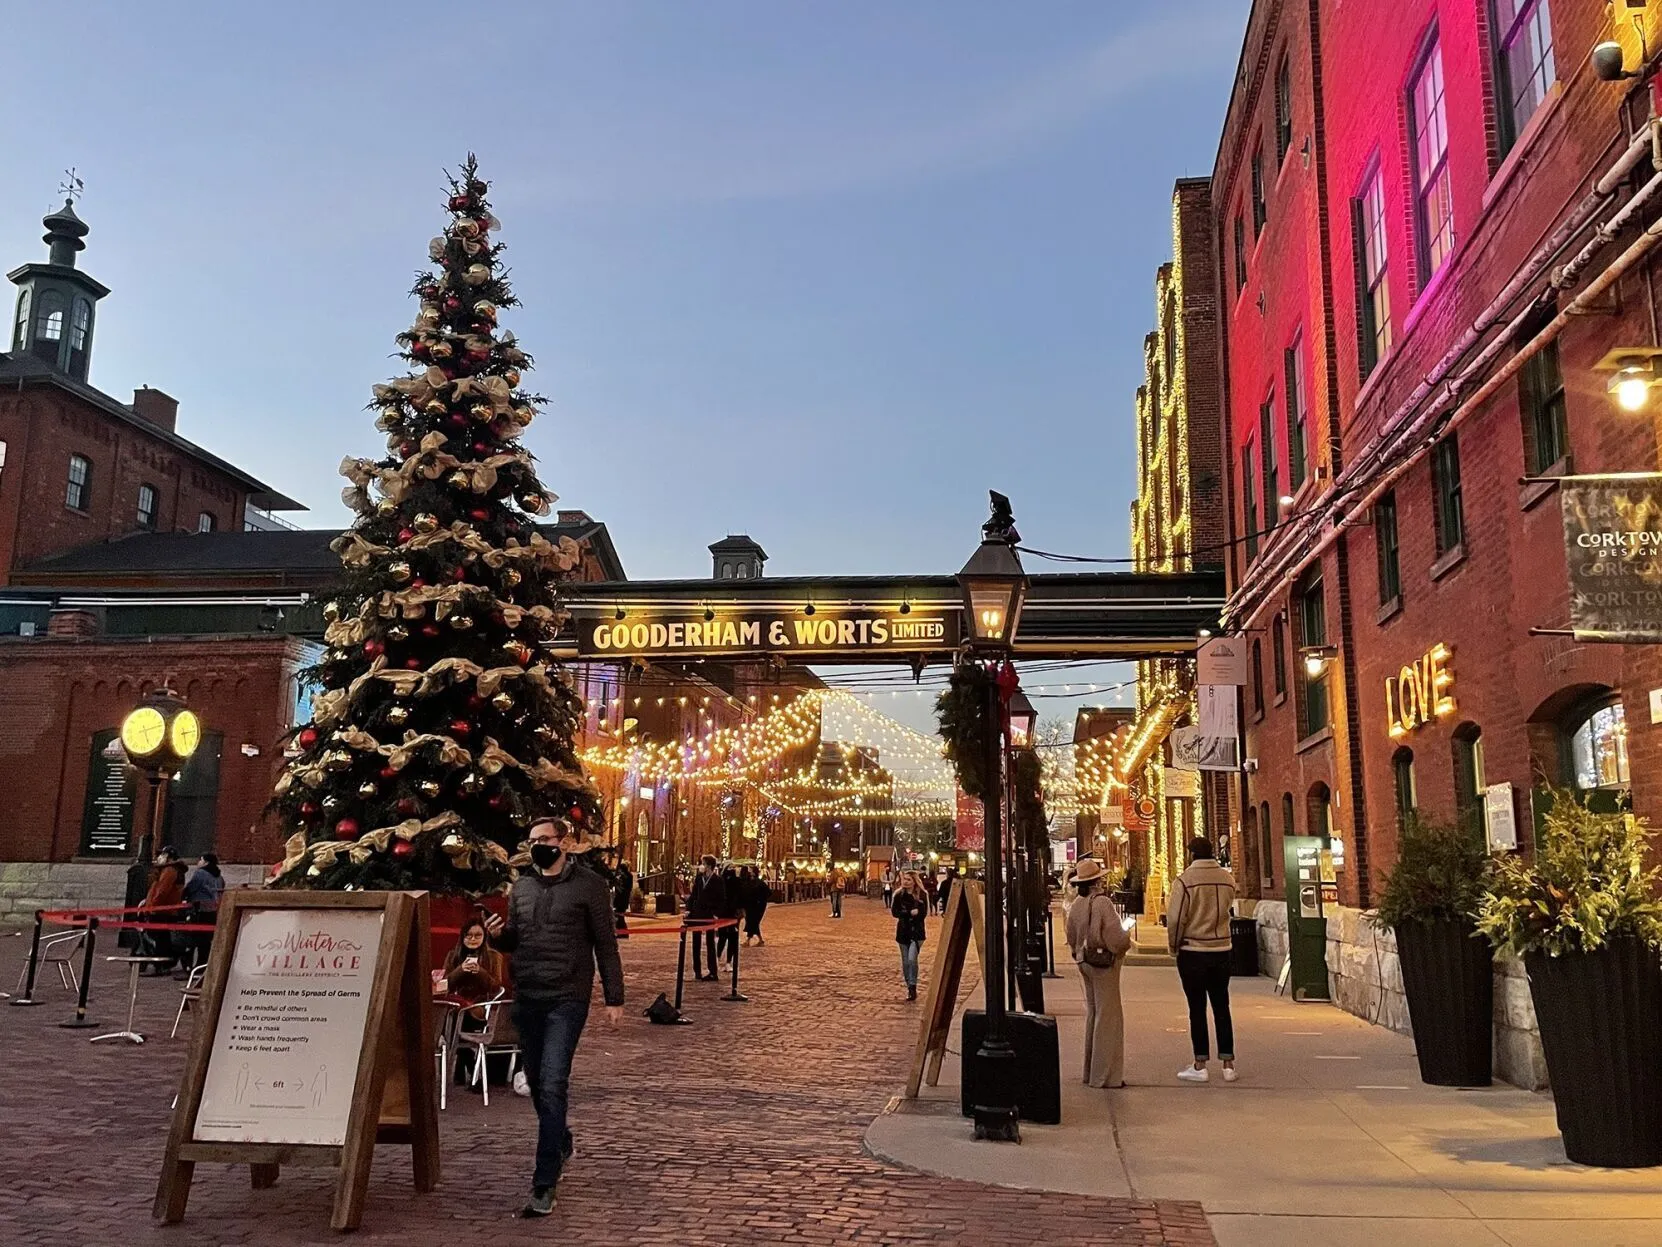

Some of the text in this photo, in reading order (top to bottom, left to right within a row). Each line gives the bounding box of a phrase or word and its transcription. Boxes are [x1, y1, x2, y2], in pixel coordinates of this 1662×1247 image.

[1599, 548, 1658, 558] DESIGN
[593, 618, 944, 649] GOODERHAM & WORTS LIMITED
[1385, 642, 1458, 737] LOVE
[284, 930, 338, 953] Winter
[256, 955, 361, 969] VILLAGE
[241, 989, 257, 997] Help
[259, 989, 286, 997] Prevent
[301, 990, 326, 998] Spread
[338, 990, 361, 998] Germs
[273, 1080, 284, 1089] 6ft
